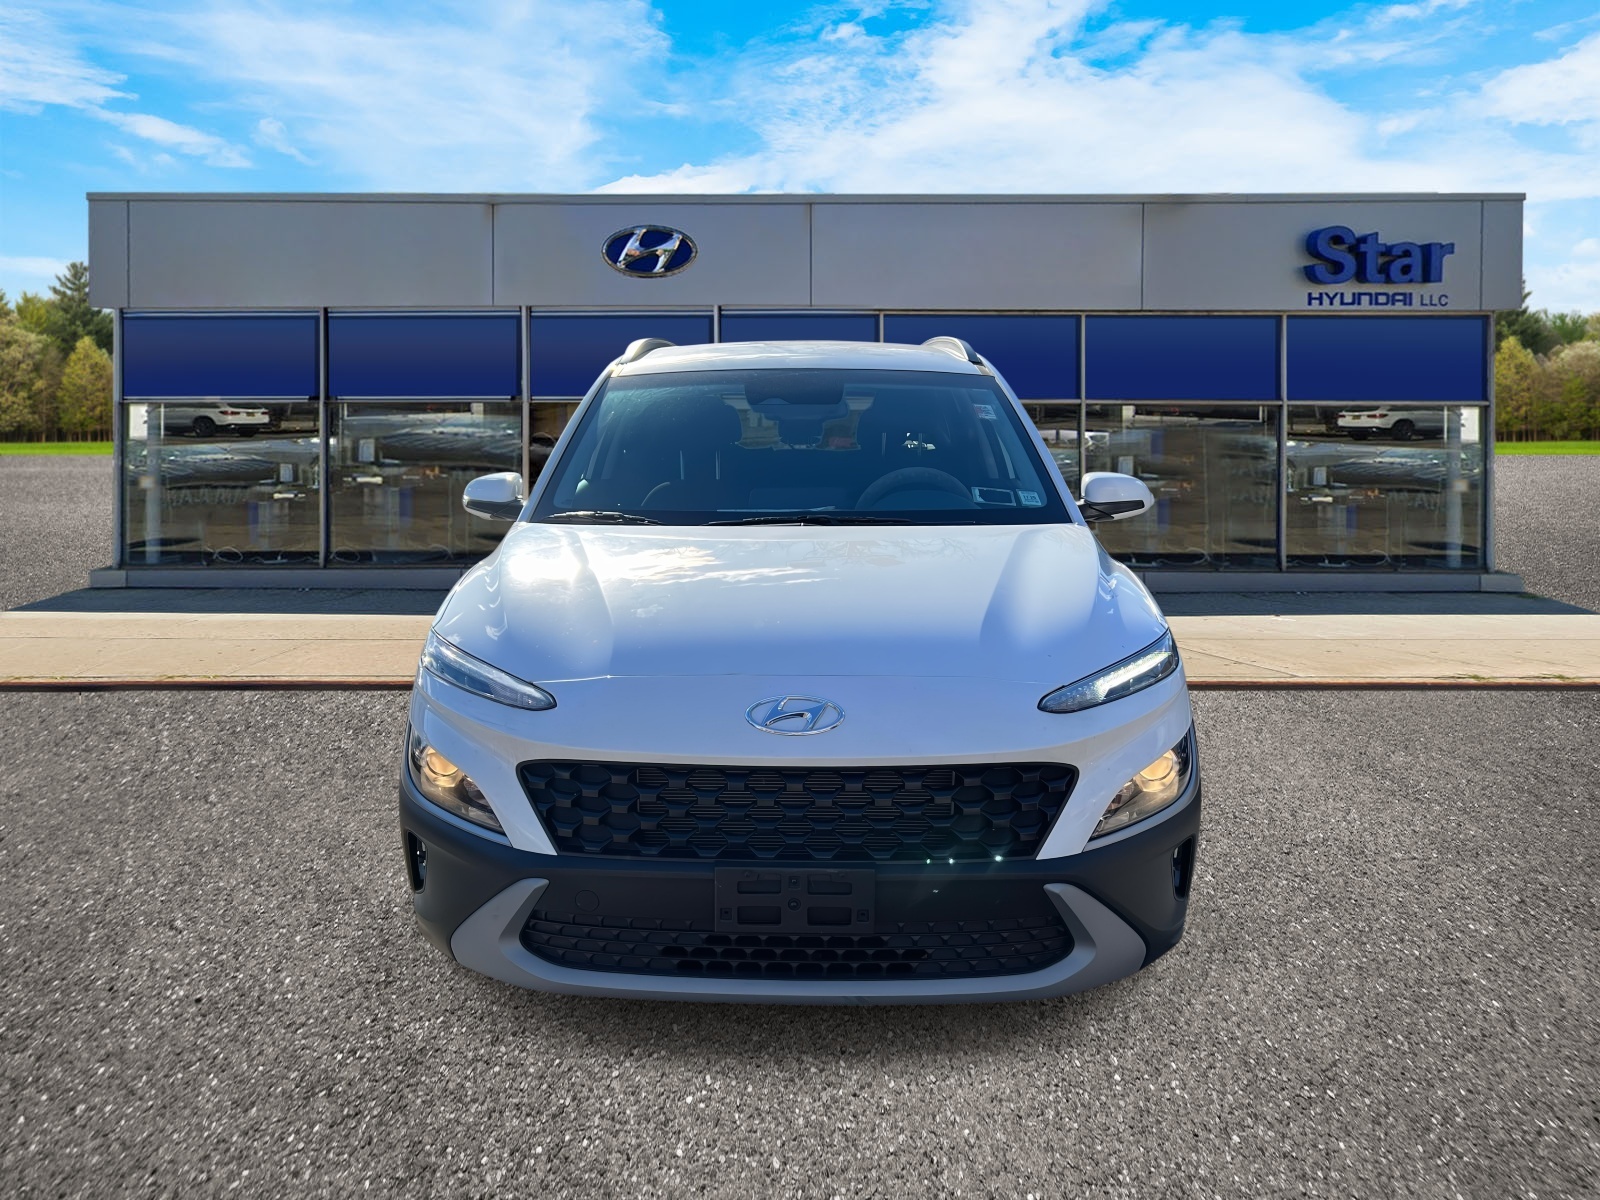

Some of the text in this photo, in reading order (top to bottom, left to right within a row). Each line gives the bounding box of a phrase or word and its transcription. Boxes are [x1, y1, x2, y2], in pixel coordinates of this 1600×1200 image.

[1304, 225, 1455, 285] Star
[1307, 292, 1449, 307] HYUNDAI LLC
